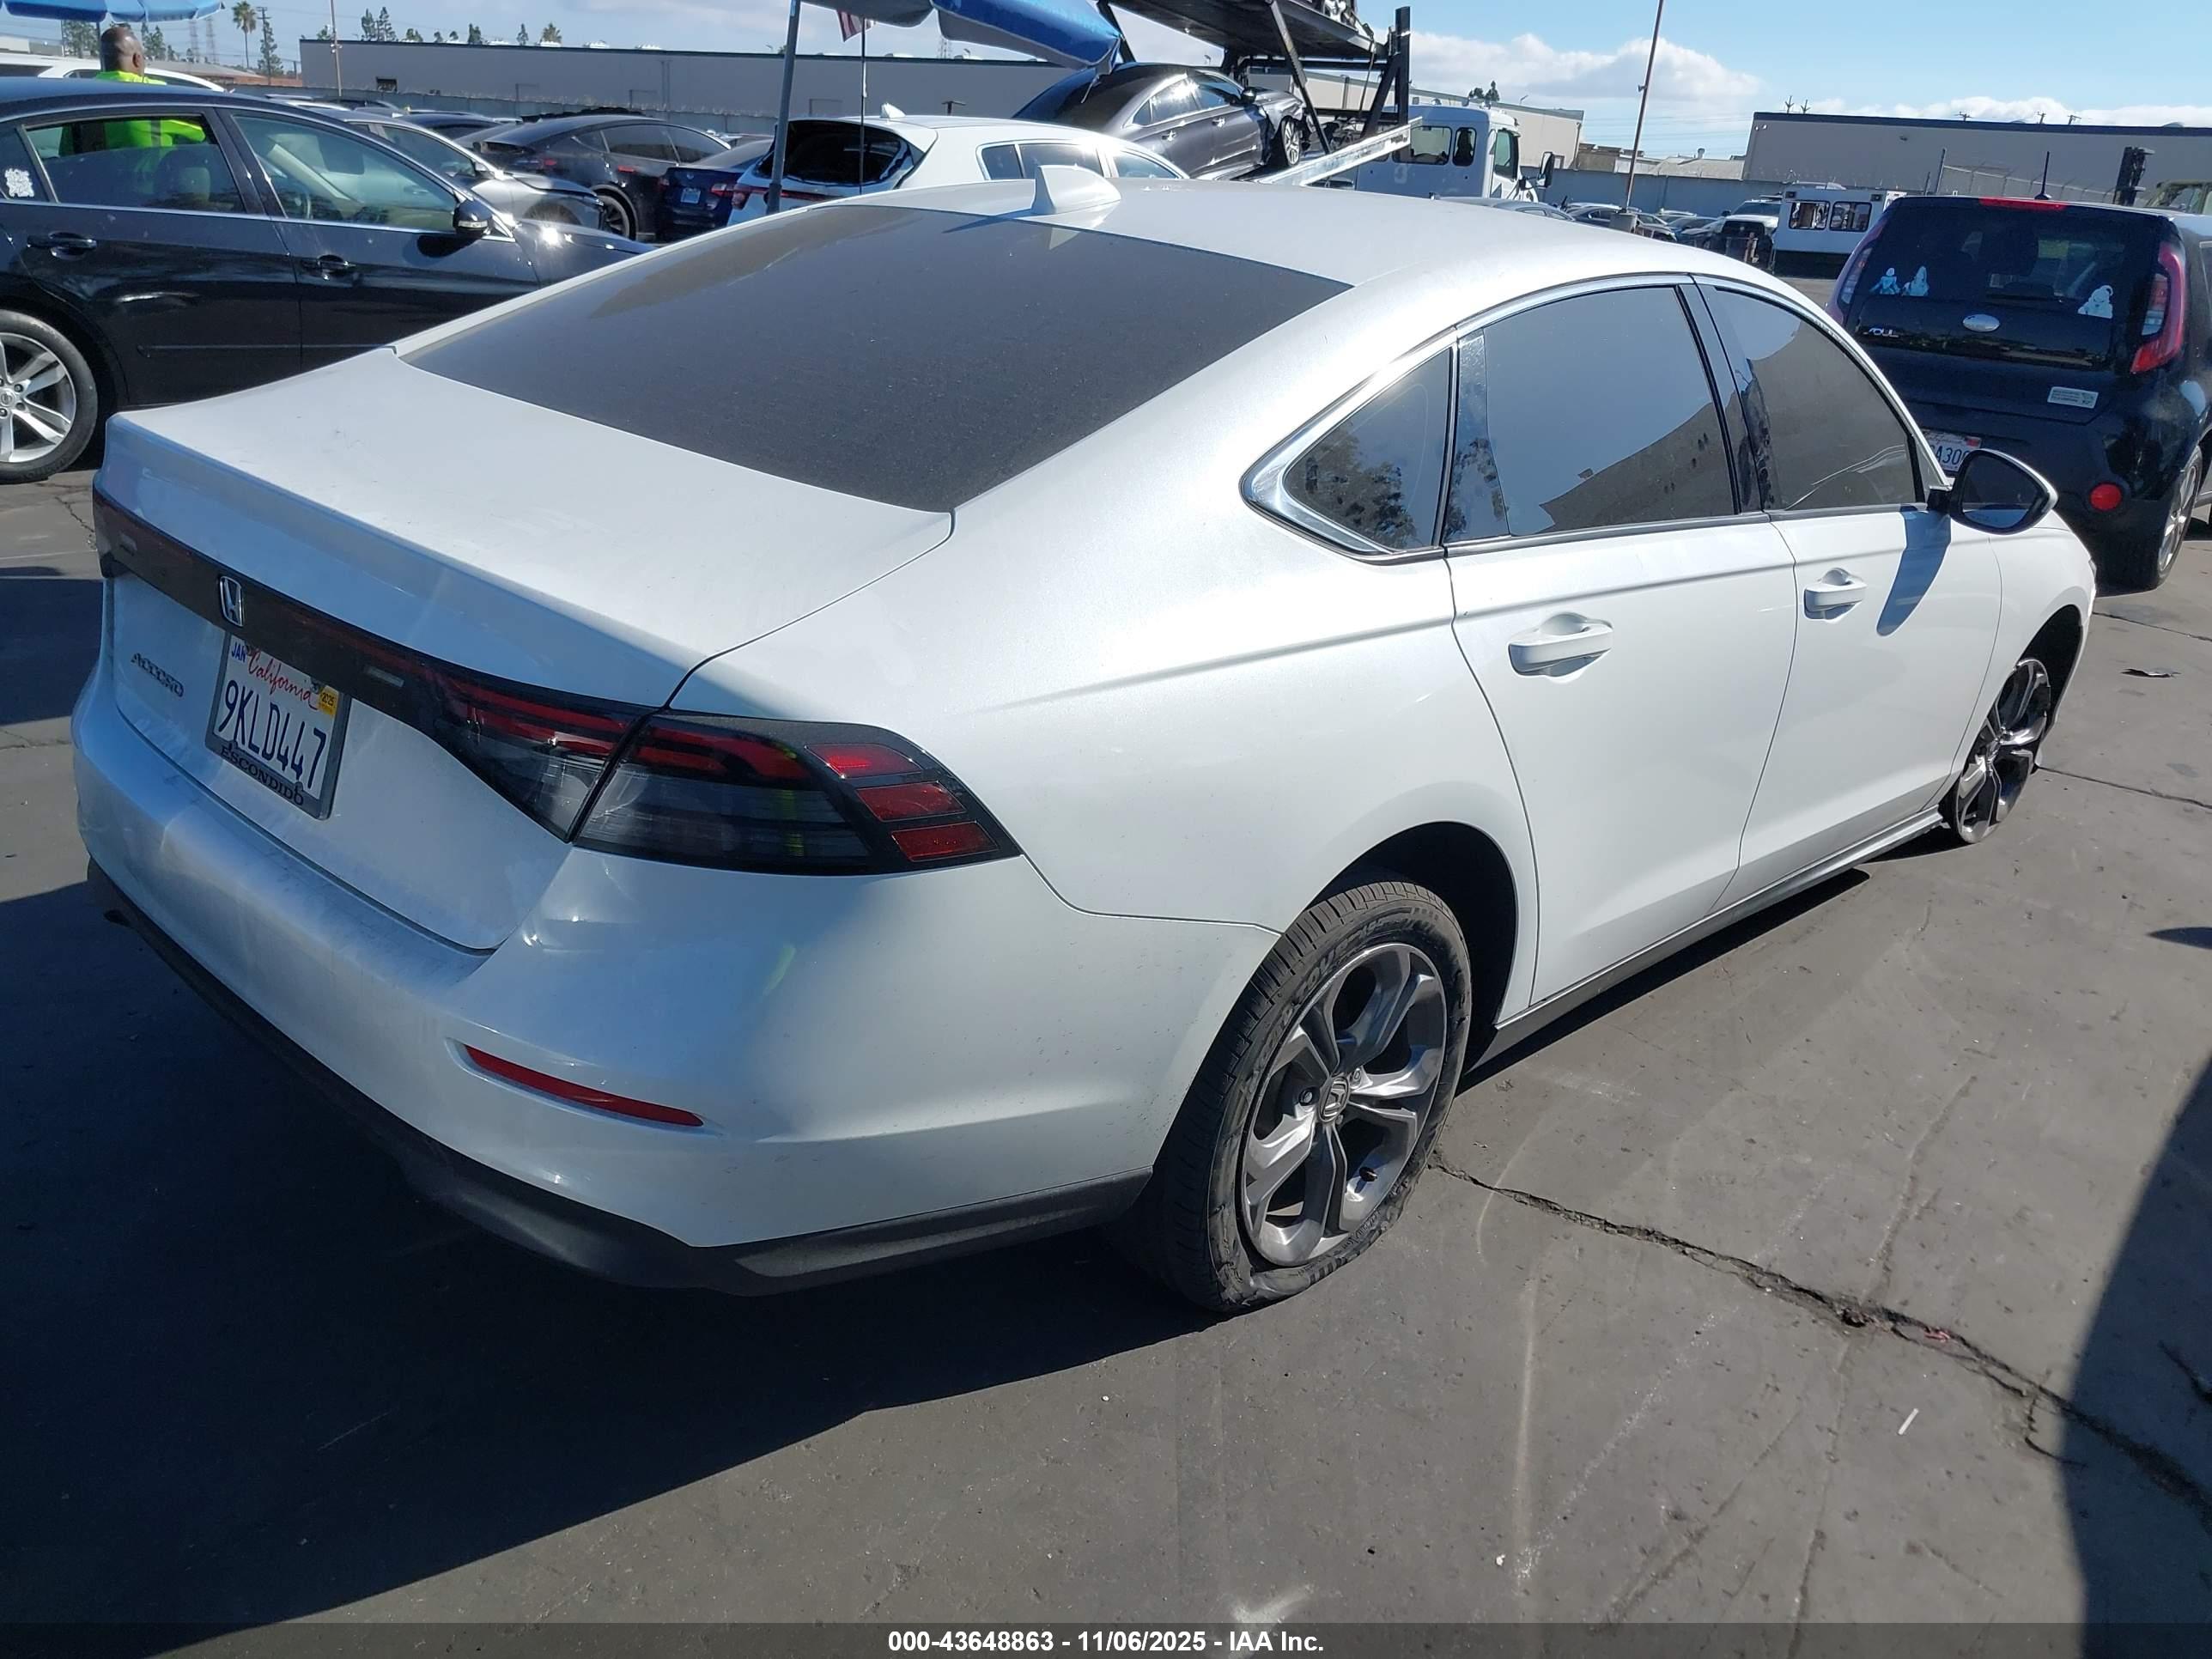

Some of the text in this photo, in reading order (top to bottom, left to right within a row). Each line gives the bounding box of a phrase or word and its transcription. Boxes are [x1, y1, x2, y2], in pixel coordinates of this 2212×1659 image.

[131, 653, 184, 697] ACCORD
[231, 641, 246, 663] JAN
[248, 647, 318, 710] California
[218, 679, 327, 789] 9KLD447
[221, 744, 304, 806] ESCONDIDO
